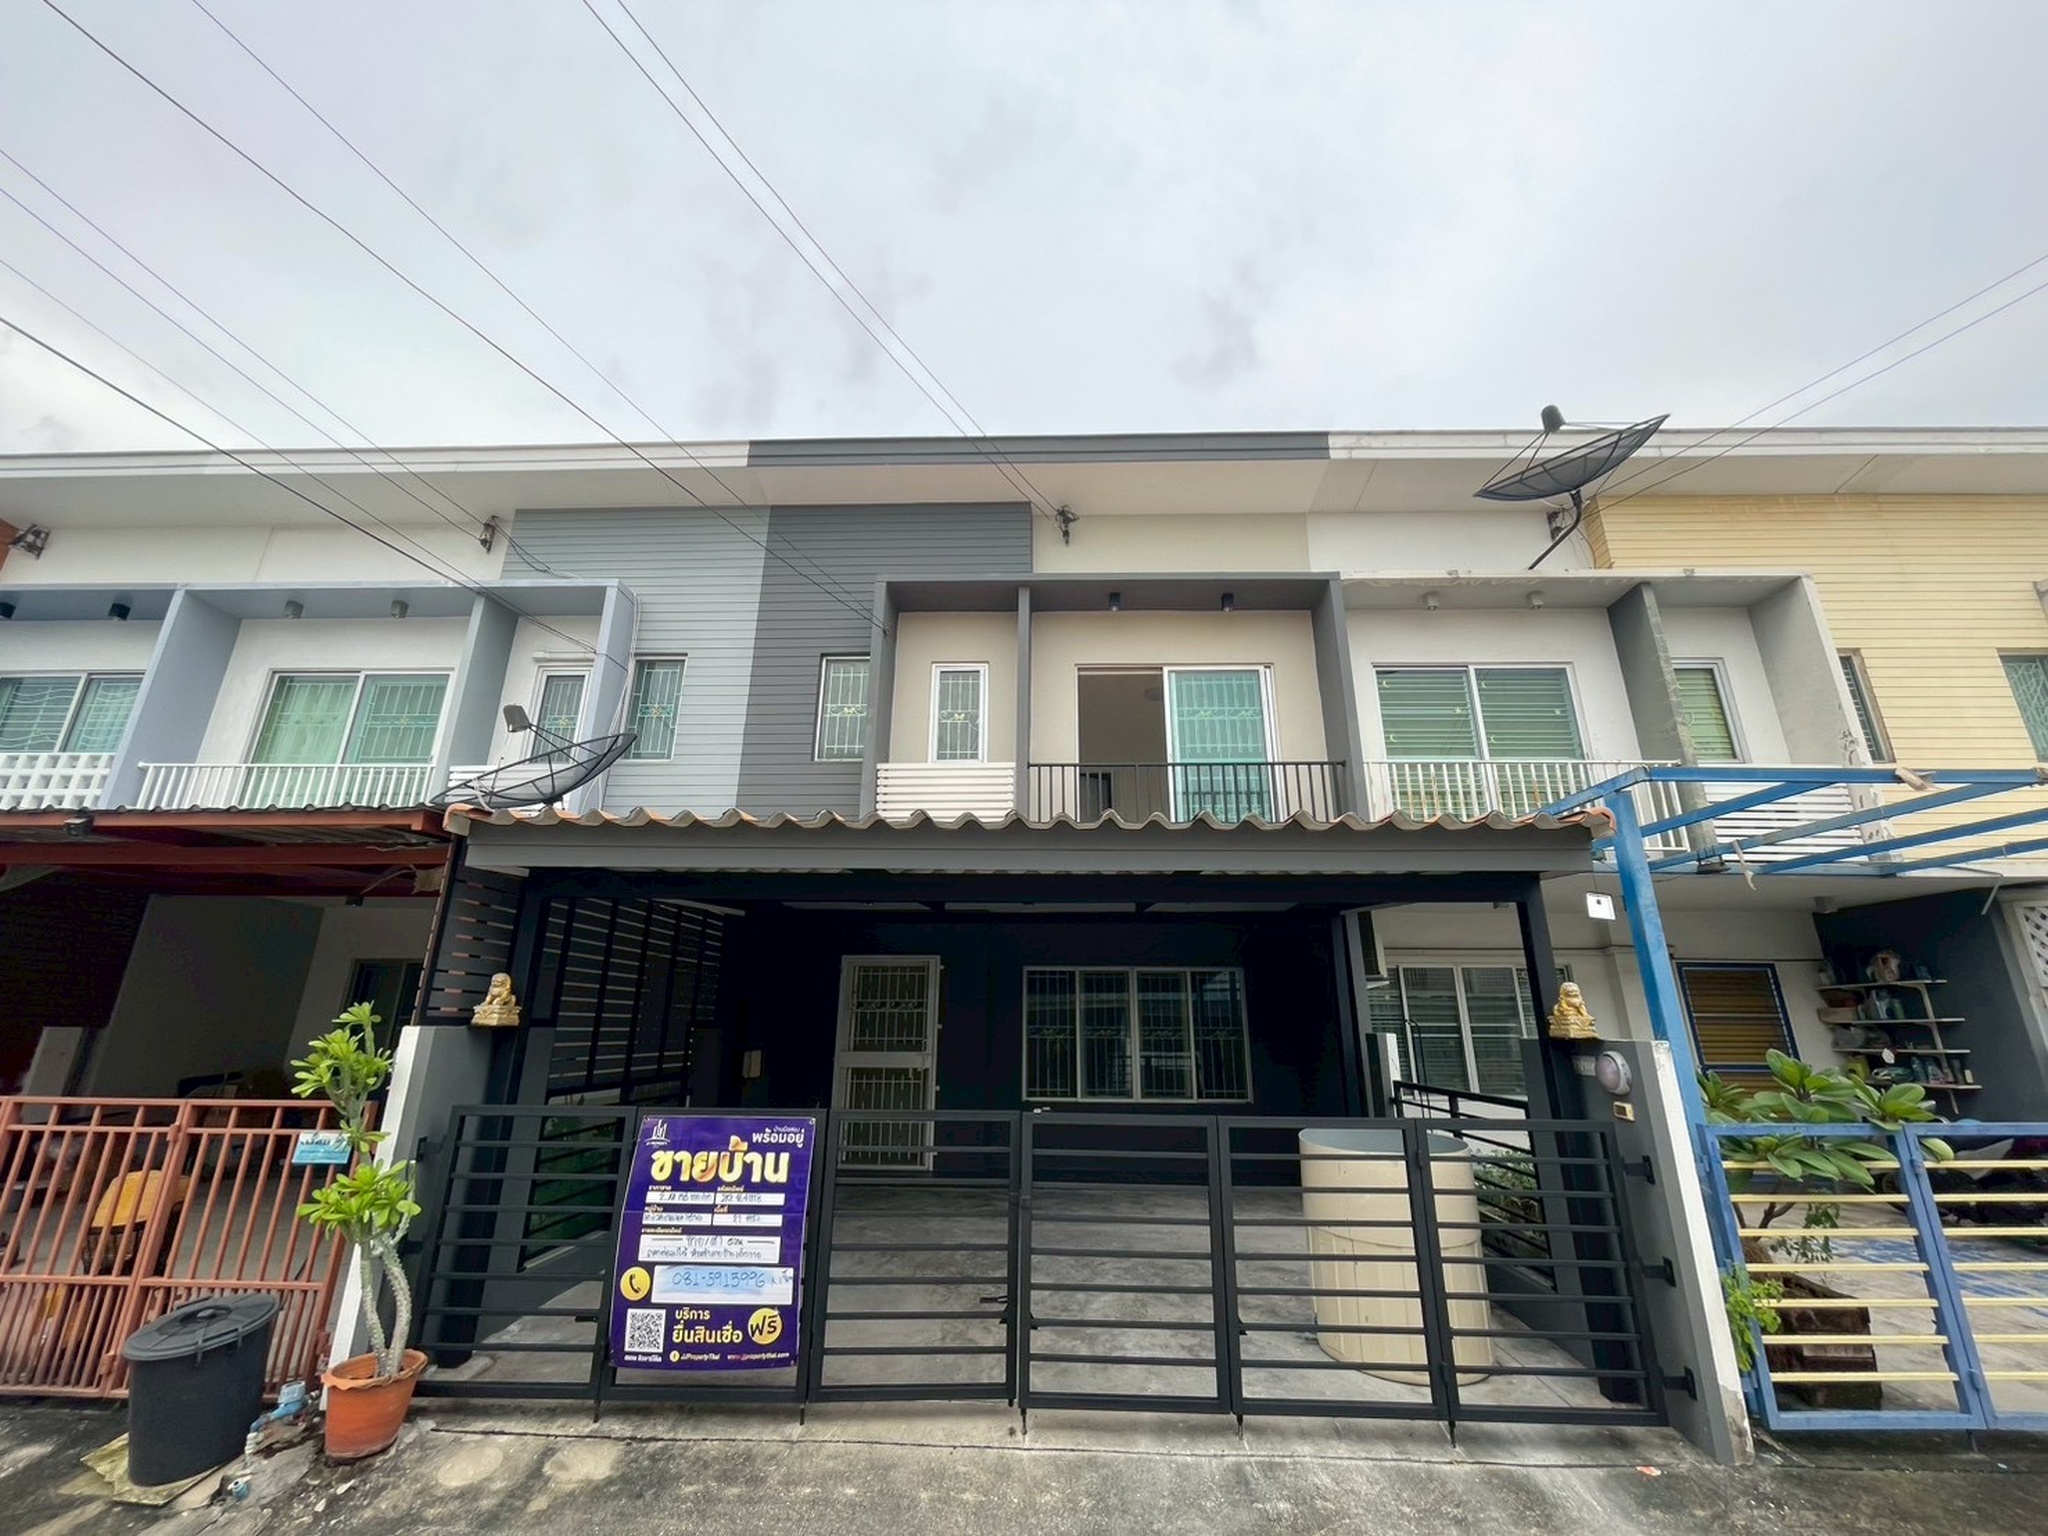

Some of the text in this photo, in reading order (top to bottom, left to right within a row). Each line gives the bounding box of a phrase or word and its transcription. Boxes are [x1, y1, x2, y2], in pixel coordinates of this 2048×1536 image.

[752, 1127, 805, 1149] พร้อมอยู่
[650, 1135, 791, 1183] ขายบ้าน
[674, 1307, 711, 1321] บริการ
[749, 1313, 779, 1338] ฟรี
[672, 1320, 744, 1344] ยื่นสินเชื่อ
